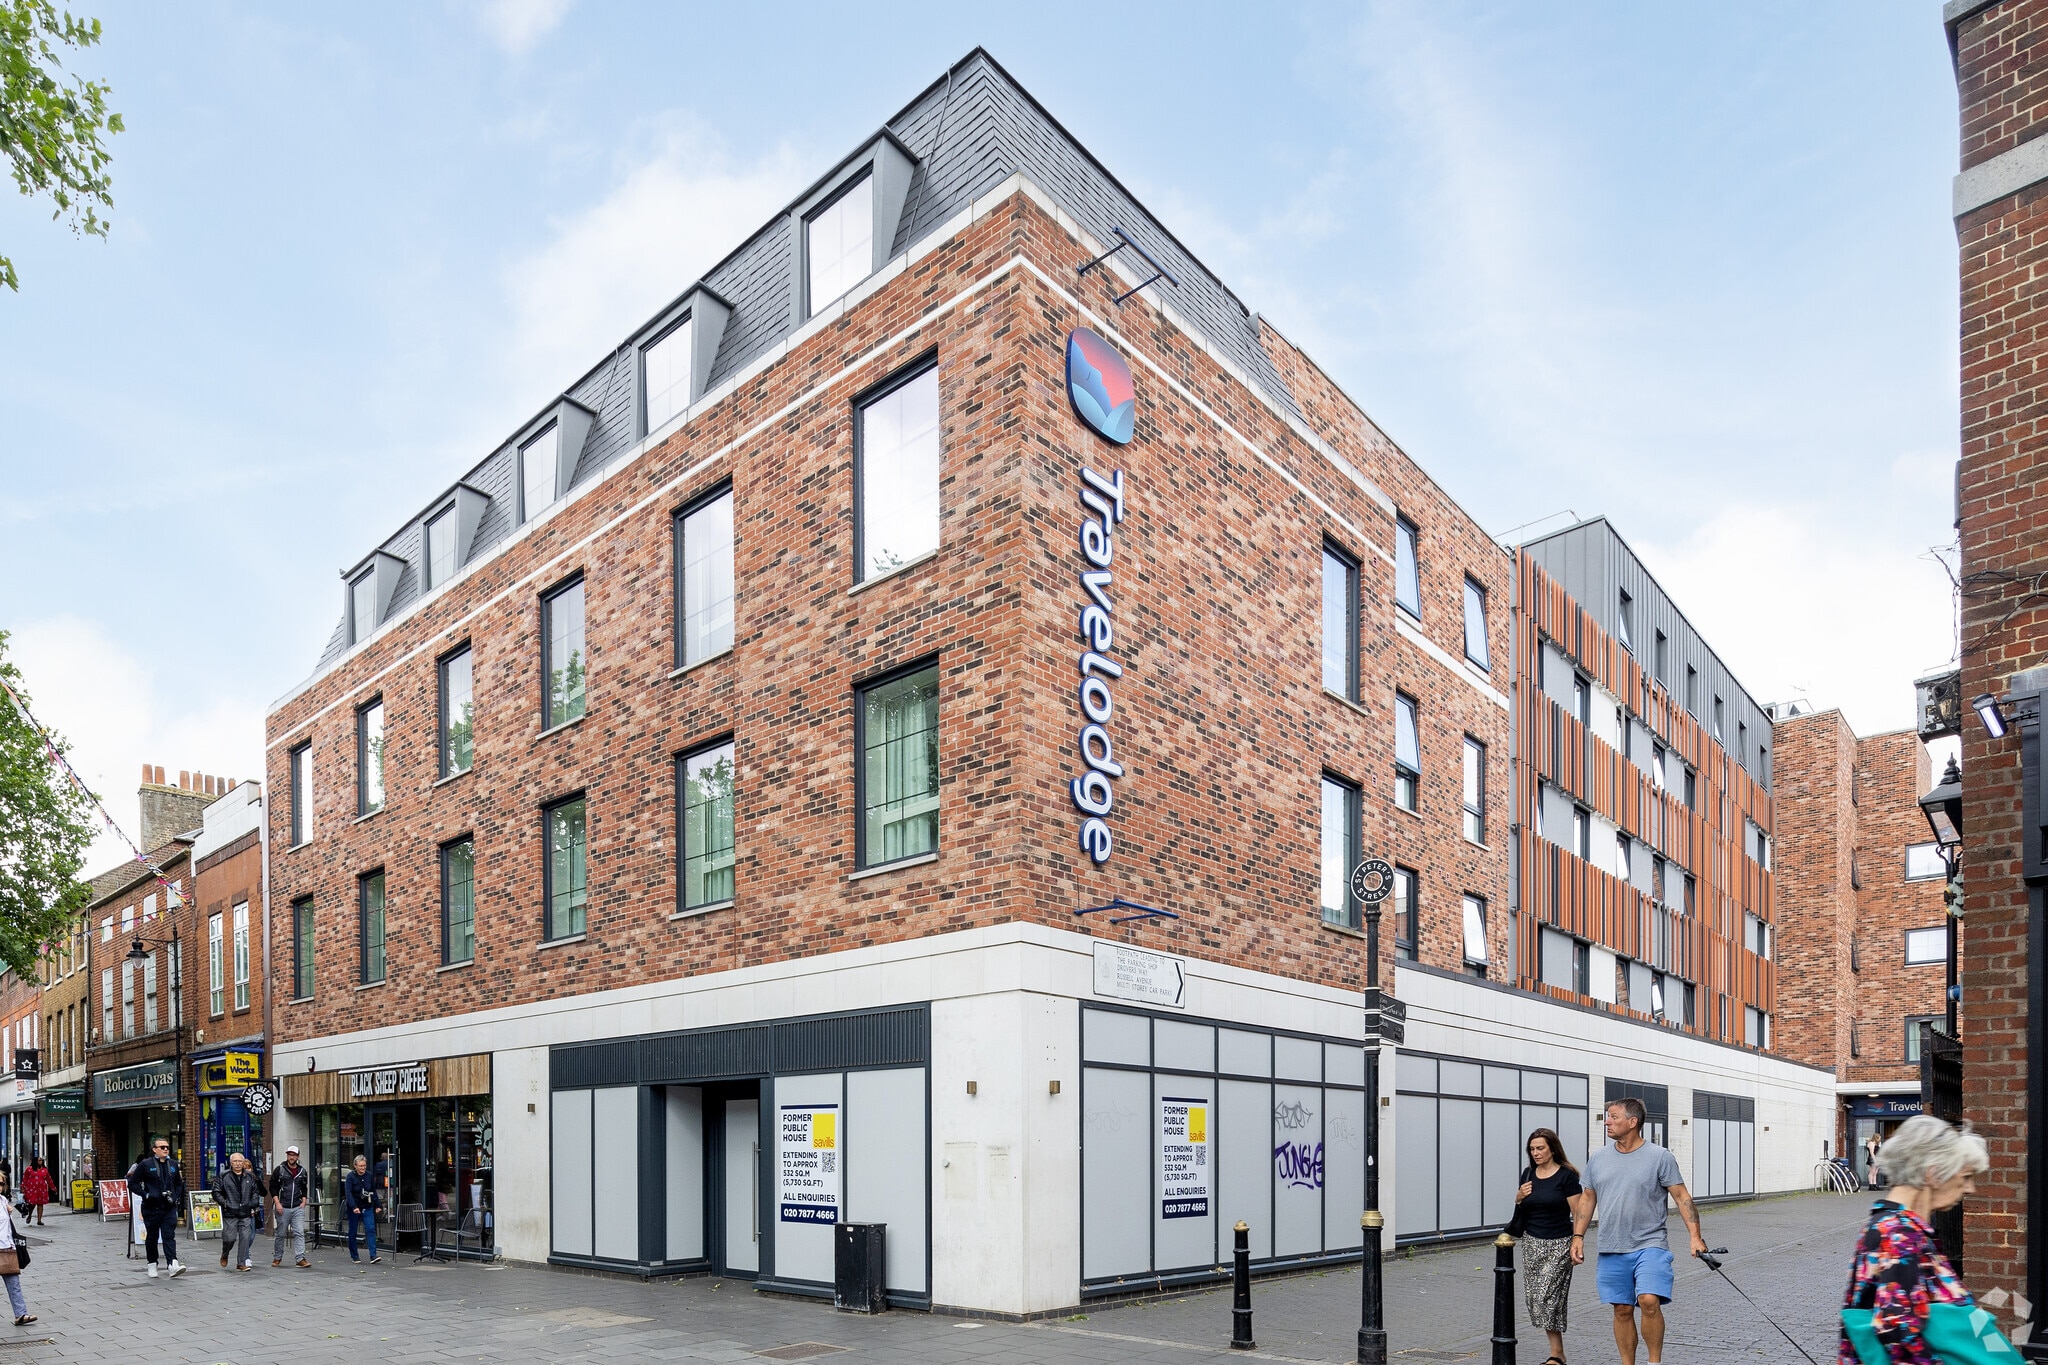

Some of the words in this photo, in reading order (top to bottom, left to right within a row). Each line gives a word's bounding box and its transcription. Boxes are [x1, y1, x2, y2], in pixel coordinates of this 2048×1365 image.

[1072, 466, 1124, 866] Travelodge
[1355, 873, 1362, 883] ST
[1361, 862, 1391, 881] PETER'S
[1357, 886, 1388, 899] STREET
[1116, 947, 1139, 958] FOOTPATH
[1141, 953, 1158, 963] LEADING
[1159, 957, 1166, 965] TO
[1117, 956, 1126, 964] THE
[1127, 959, 1146, 968] PARKING
[1131, 984, 1147, 992] STOREY
[1149, 986, 1158, 994] CAR
[1159, 988, 1173, 996] PARKS
[235, 1058, 250, 1066] The
[230, 1066, 255, 1074] Works
[104, 1076, 141, 1093] Robert
[144, 1072, 174, 1090] Dyas
[351, 1073, 373, 1097] BLACK
[375, 1070, 397, 1095] SHEEP
[400, 1067, 427, 1093] COFFEE
[244, 1086, 256, 1103] BLACK
[256, 1085, 272, 1099] SHEEP
[250, 1103, 272, 1114] COFFEE
[1164, 1106, 1188, 1115] FORMER
[783, 1114, 812, 1122] FORMER
[1164, 1117, 1185, 1125] PUBLIC
[783, 1124, 808, 1132] PUBLIC
[1164, 1127, 1184, 1135] HOUSE
[783, 1134, 807, 1142] HOUSE
[1189, 1131, 1206, 1141] savills
[813, 1136, 835, 1148] savills
[1164, 1145, 1193, 1153] EXTENDING
[1172, 1154, 1193, 1162] APPROX
[783, 1178, 802, 1187] (5,730
[803, 1179, 824, 1187] SQ.FT)
[1164, 1173, 1180, 1182] (5,730
[1180, 1173, 1197, 1181] SQ.FT)
[103, 1190, 127, 1198] SALE
[1164, 1188, 1175, 1196] ALL
[1176, 1186, 1206, 1196] ENQUIRIES
[783, 1193, 796, 1201] ALL
[798, 1193, 836, 1203] ENQUIRIES
[1165, 1204, 1176, 1213] 020
[1177, 1203, 1191, 1213] 7877
[784, 1209, 798, 1217] 020
[798, 1209, 815, 1219] 7877
[815, 1210, 835, 1219] 4666
